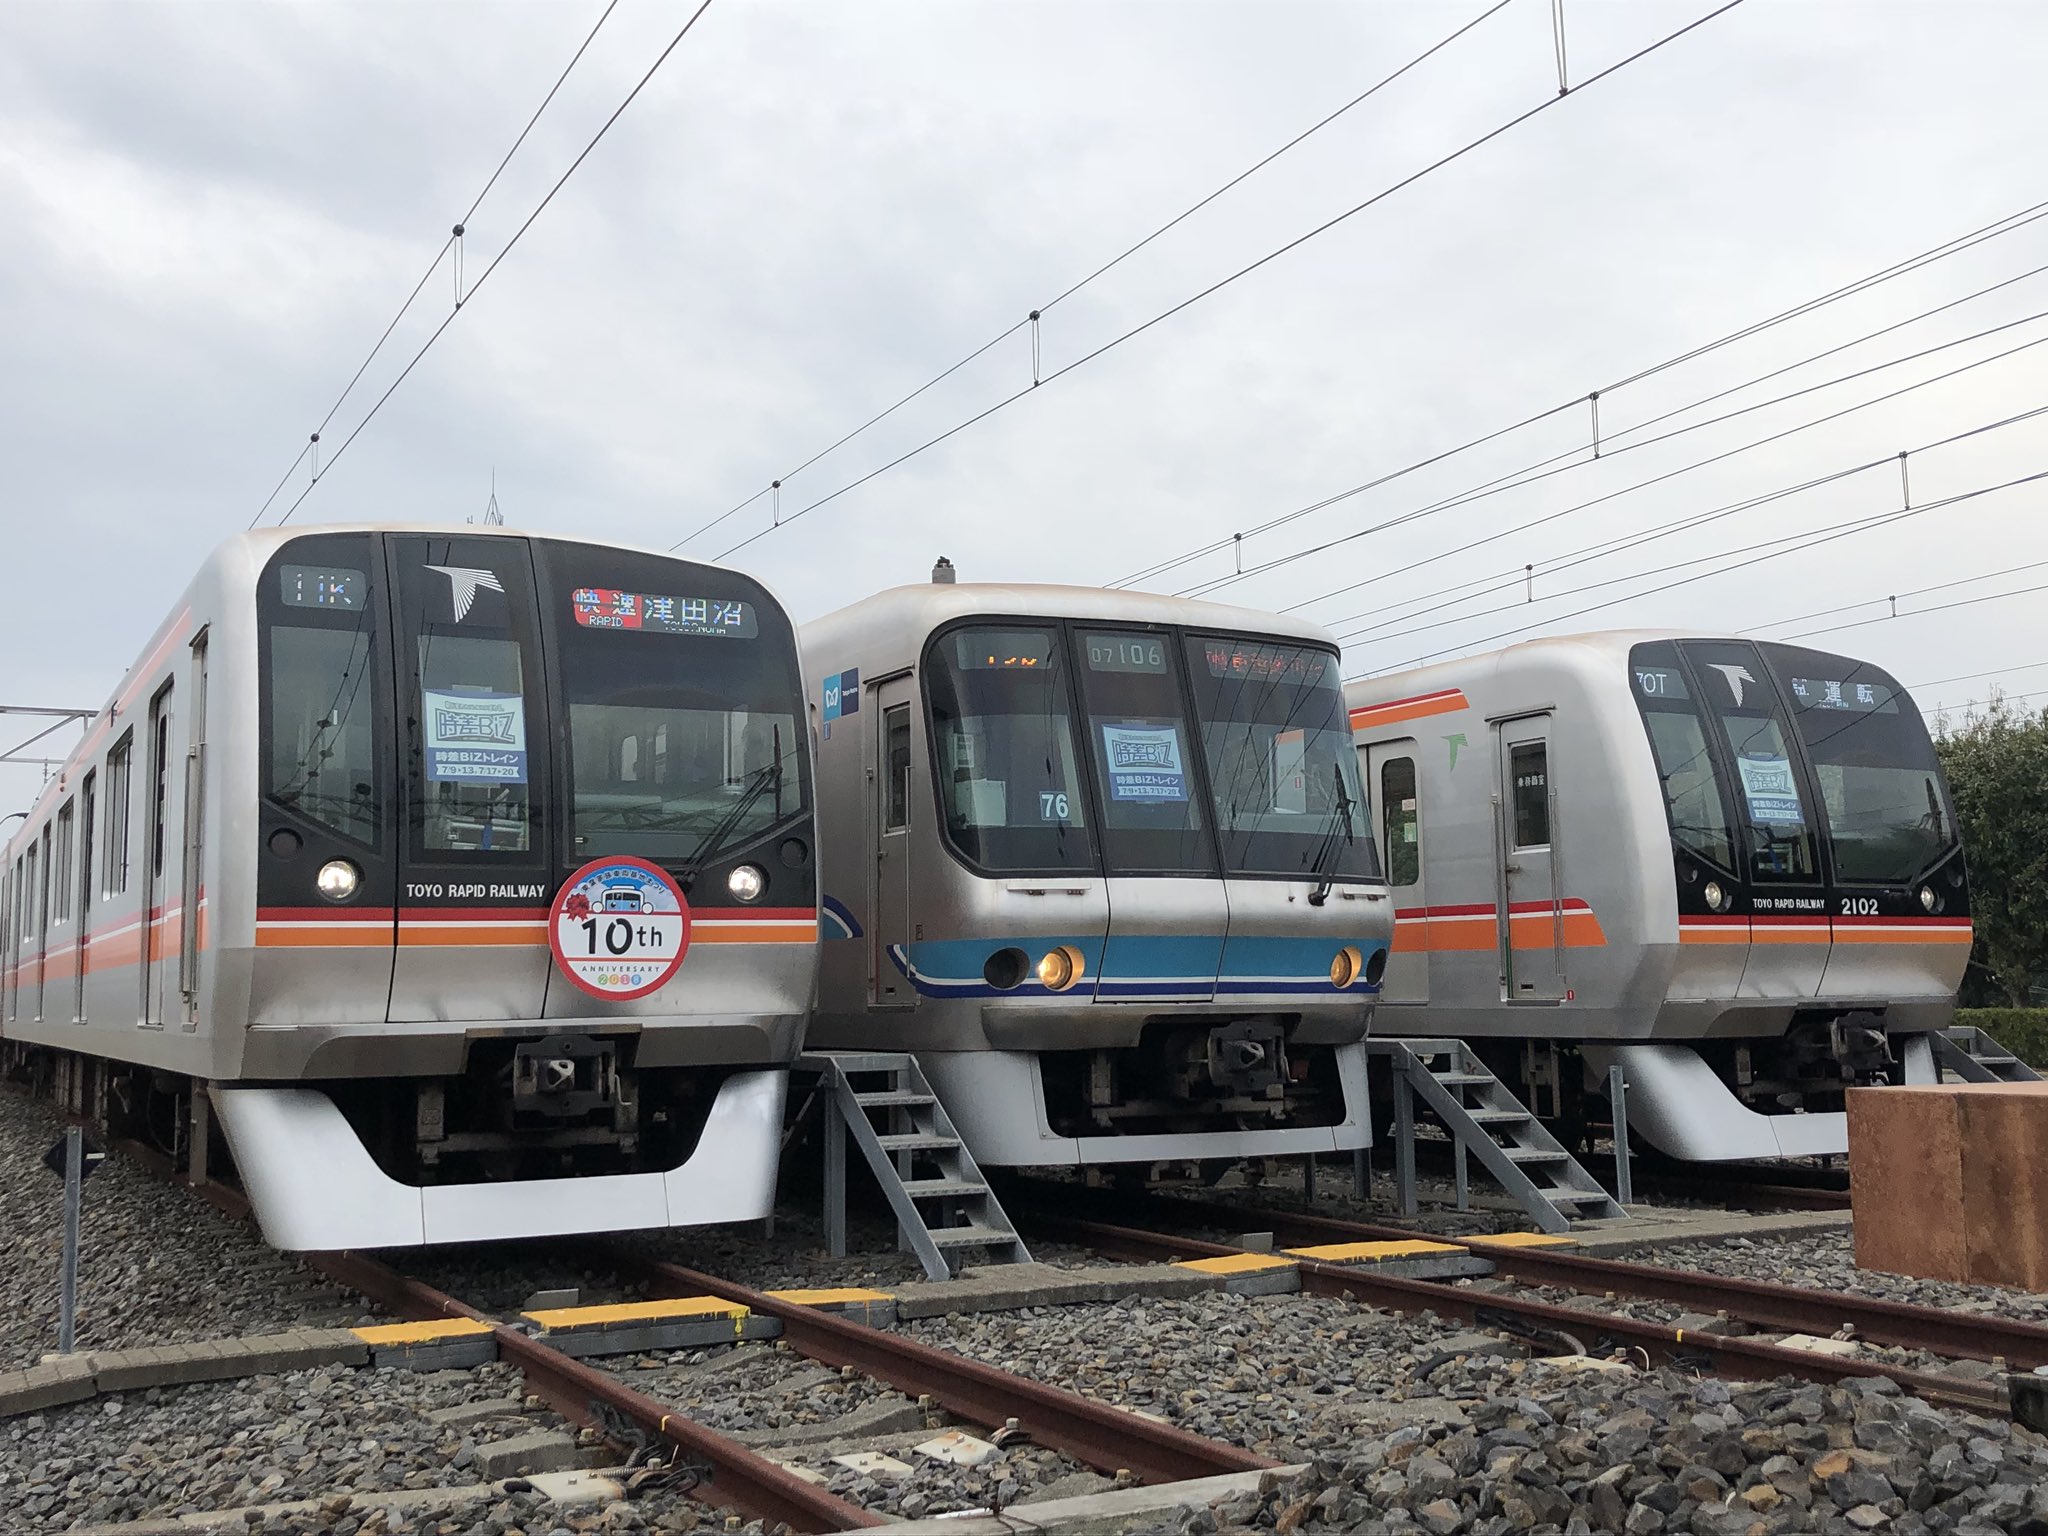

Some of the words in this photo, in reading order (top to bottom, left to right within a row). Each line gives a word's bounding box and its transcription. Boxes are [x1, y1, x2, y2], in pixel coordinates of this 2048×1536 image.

[576, 588, 636, 616] 快速
[645, 596, 742, 626] 津田沼
[589, 615, 623, 627] RAPID
[438, 711, 514, 742] 時差BiZ
[435, 751, 518, 764] 時差BiZトレイン
[1041, 793, 1069, 818] 76
[406, 884, 443, 898] TOYO
[448, 884, 486, 898] RAPID
[490, 884, 545, 898] RAILWAY
[1753, 898, 1772, 908] TOYO
[1775, 898, 1794, 908] RAPID
[1796, 898, 1825, 909] RAILWAY
[1841, 898, 1879, 915] 2102
[581, 917, 663, 955] 10th
[599, 975, 641, 985] 2018
